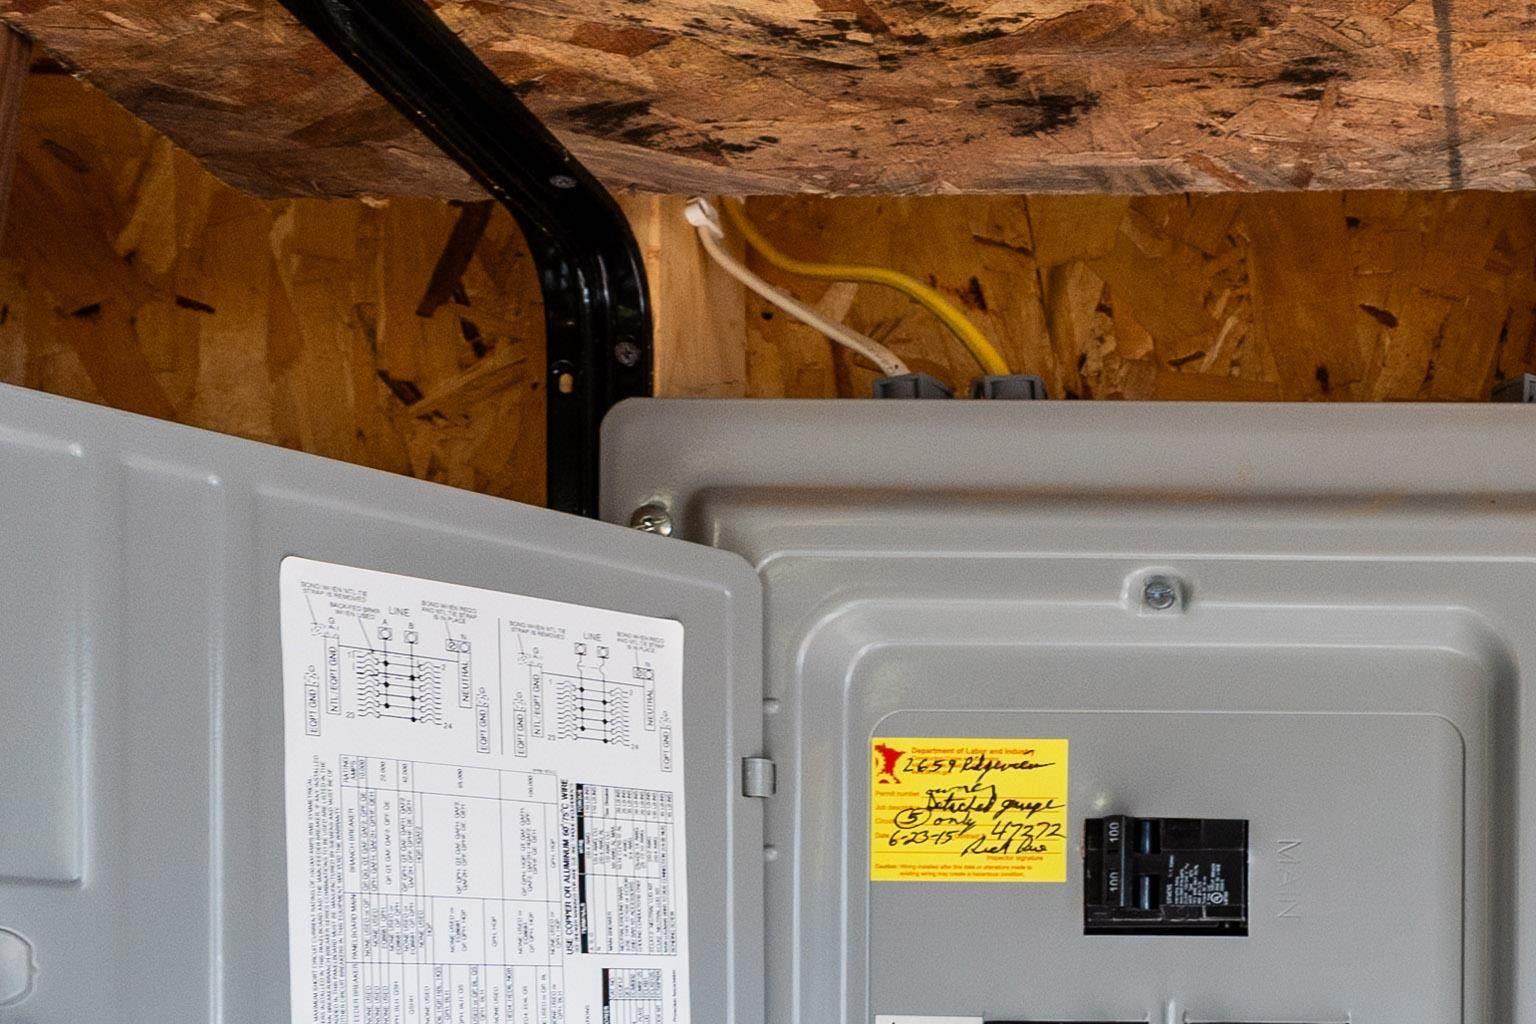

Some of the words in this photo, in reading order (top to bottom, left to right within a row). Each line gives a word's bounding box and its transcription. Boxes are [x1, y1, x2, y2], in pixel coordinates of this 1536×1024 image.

[912, 747, 957, 756] Department
[903, 757, 956, 773] 2659
[560, 779, 569, 800] WIRE
[1108, 822, 1120, 843] 100
[562, 839, 571, 883] ALUMINUM
[564, 885, 572, 895] OR
[1109, 872, 1119, 893] 100
[565, 897, 573, 936] COPPER
[566, 938, 574, 955] USE
